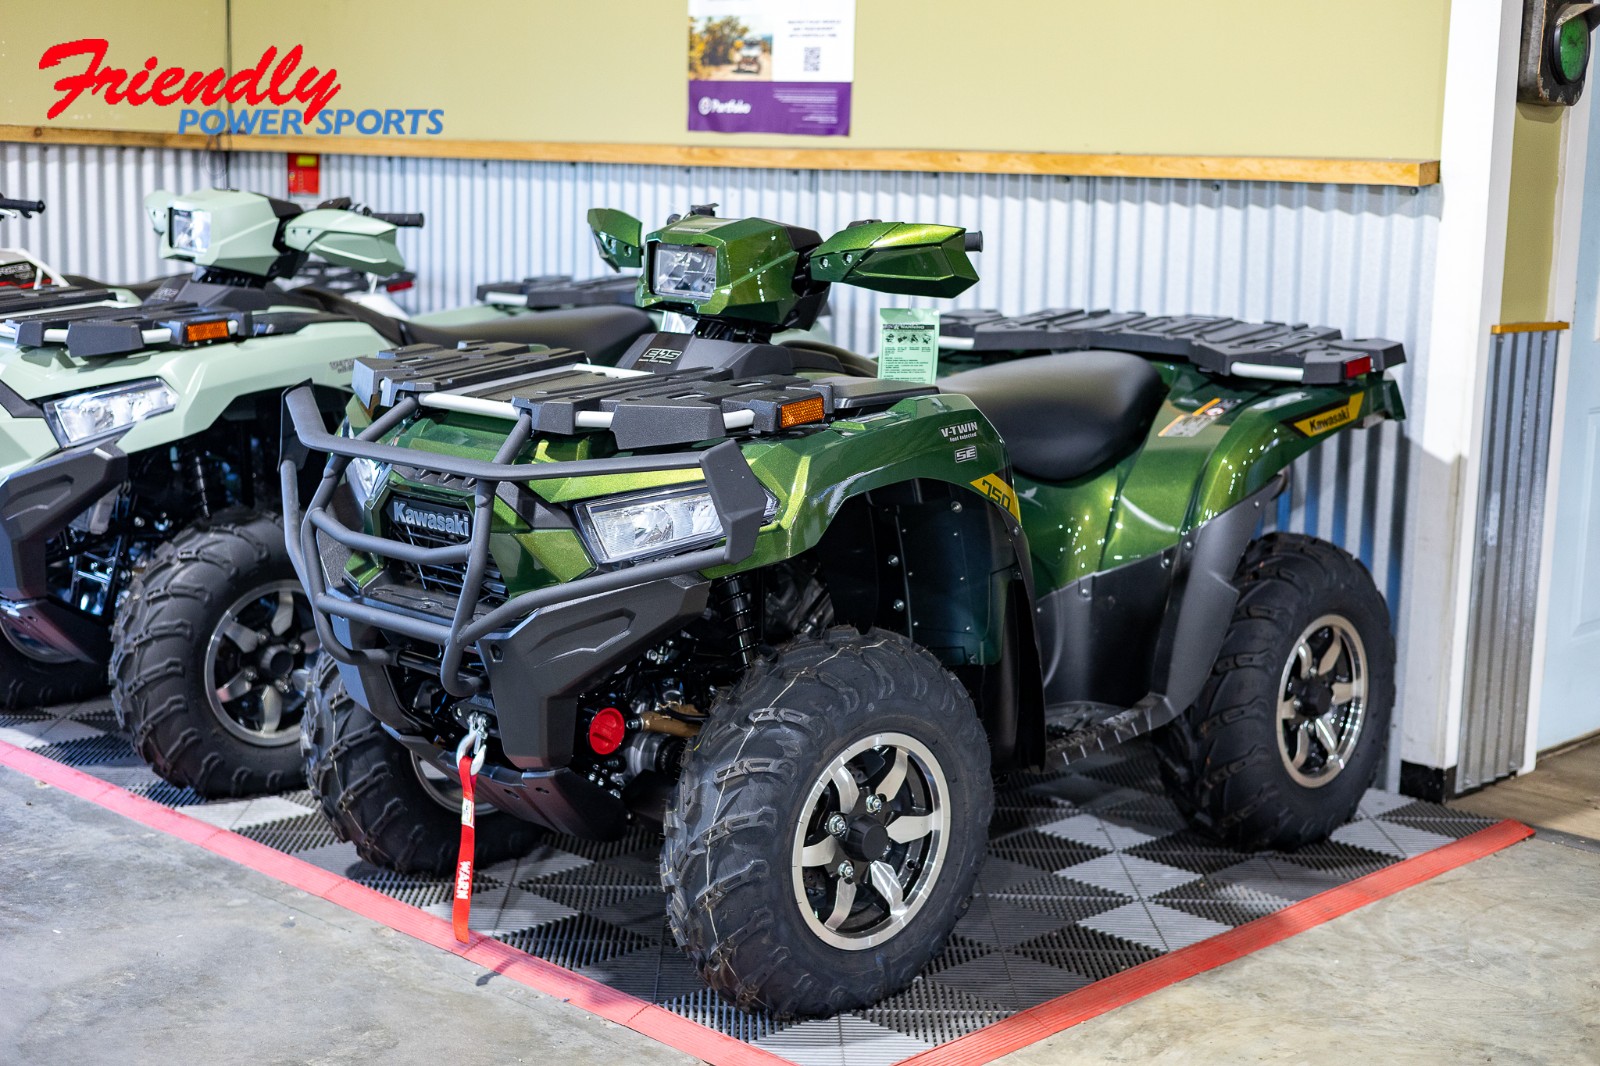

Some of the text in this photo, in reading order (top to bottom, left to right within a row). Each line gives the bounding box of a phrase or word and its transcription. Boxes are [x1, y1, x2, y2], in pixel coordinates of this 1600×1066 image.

[643, 348, 682, 360] EPS
[941, 421, 978, 437] V-TWIN
[1309, 408, 1350, 432] Kawasaki
[956, 448, 976, 461] SE
[982, 478, 1011, 511] 750
[393, 500, 470, 537] Kawasaki
[455, 860, 471, 900] WARN
